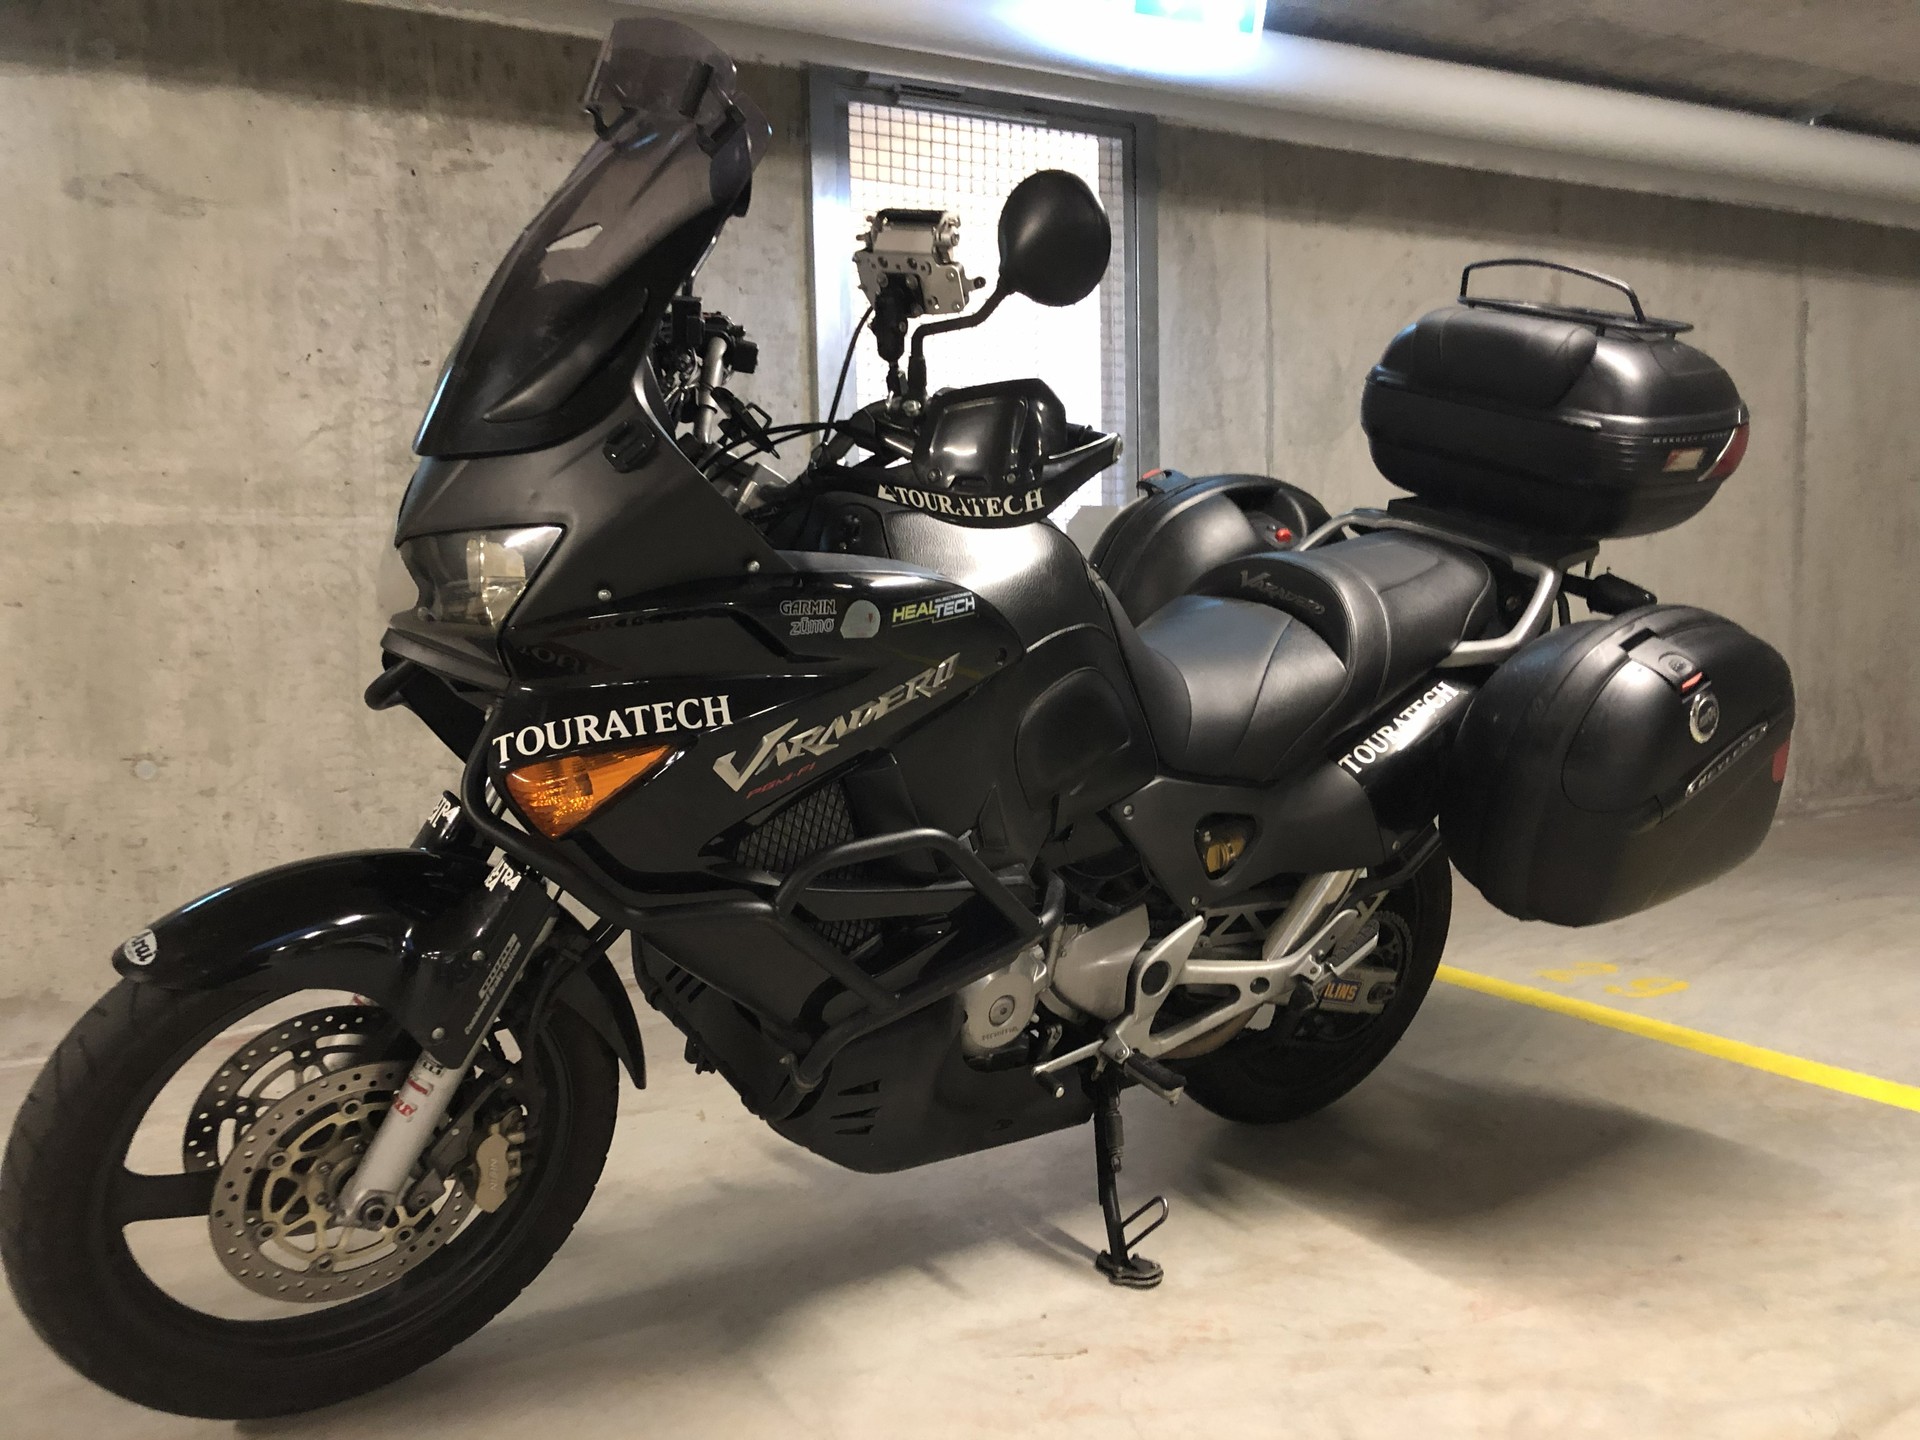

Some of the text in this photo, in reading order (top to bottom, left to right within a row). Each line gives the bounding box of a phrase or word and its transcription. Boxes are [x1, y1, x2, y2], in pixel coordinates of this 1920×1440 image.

[893, 486, 1046, 518] TOURATECH
[779, 599, 837, 616] GARMIN
[892, 596, 976, 624] HEALTECH
[492, 695, 734, 765] TOURATECH
[712, 652, 960, 793] VARADERO
[1337, 680, 1460, 774] TOURATECH
[746, 761, 816, 800] PGM-FI
